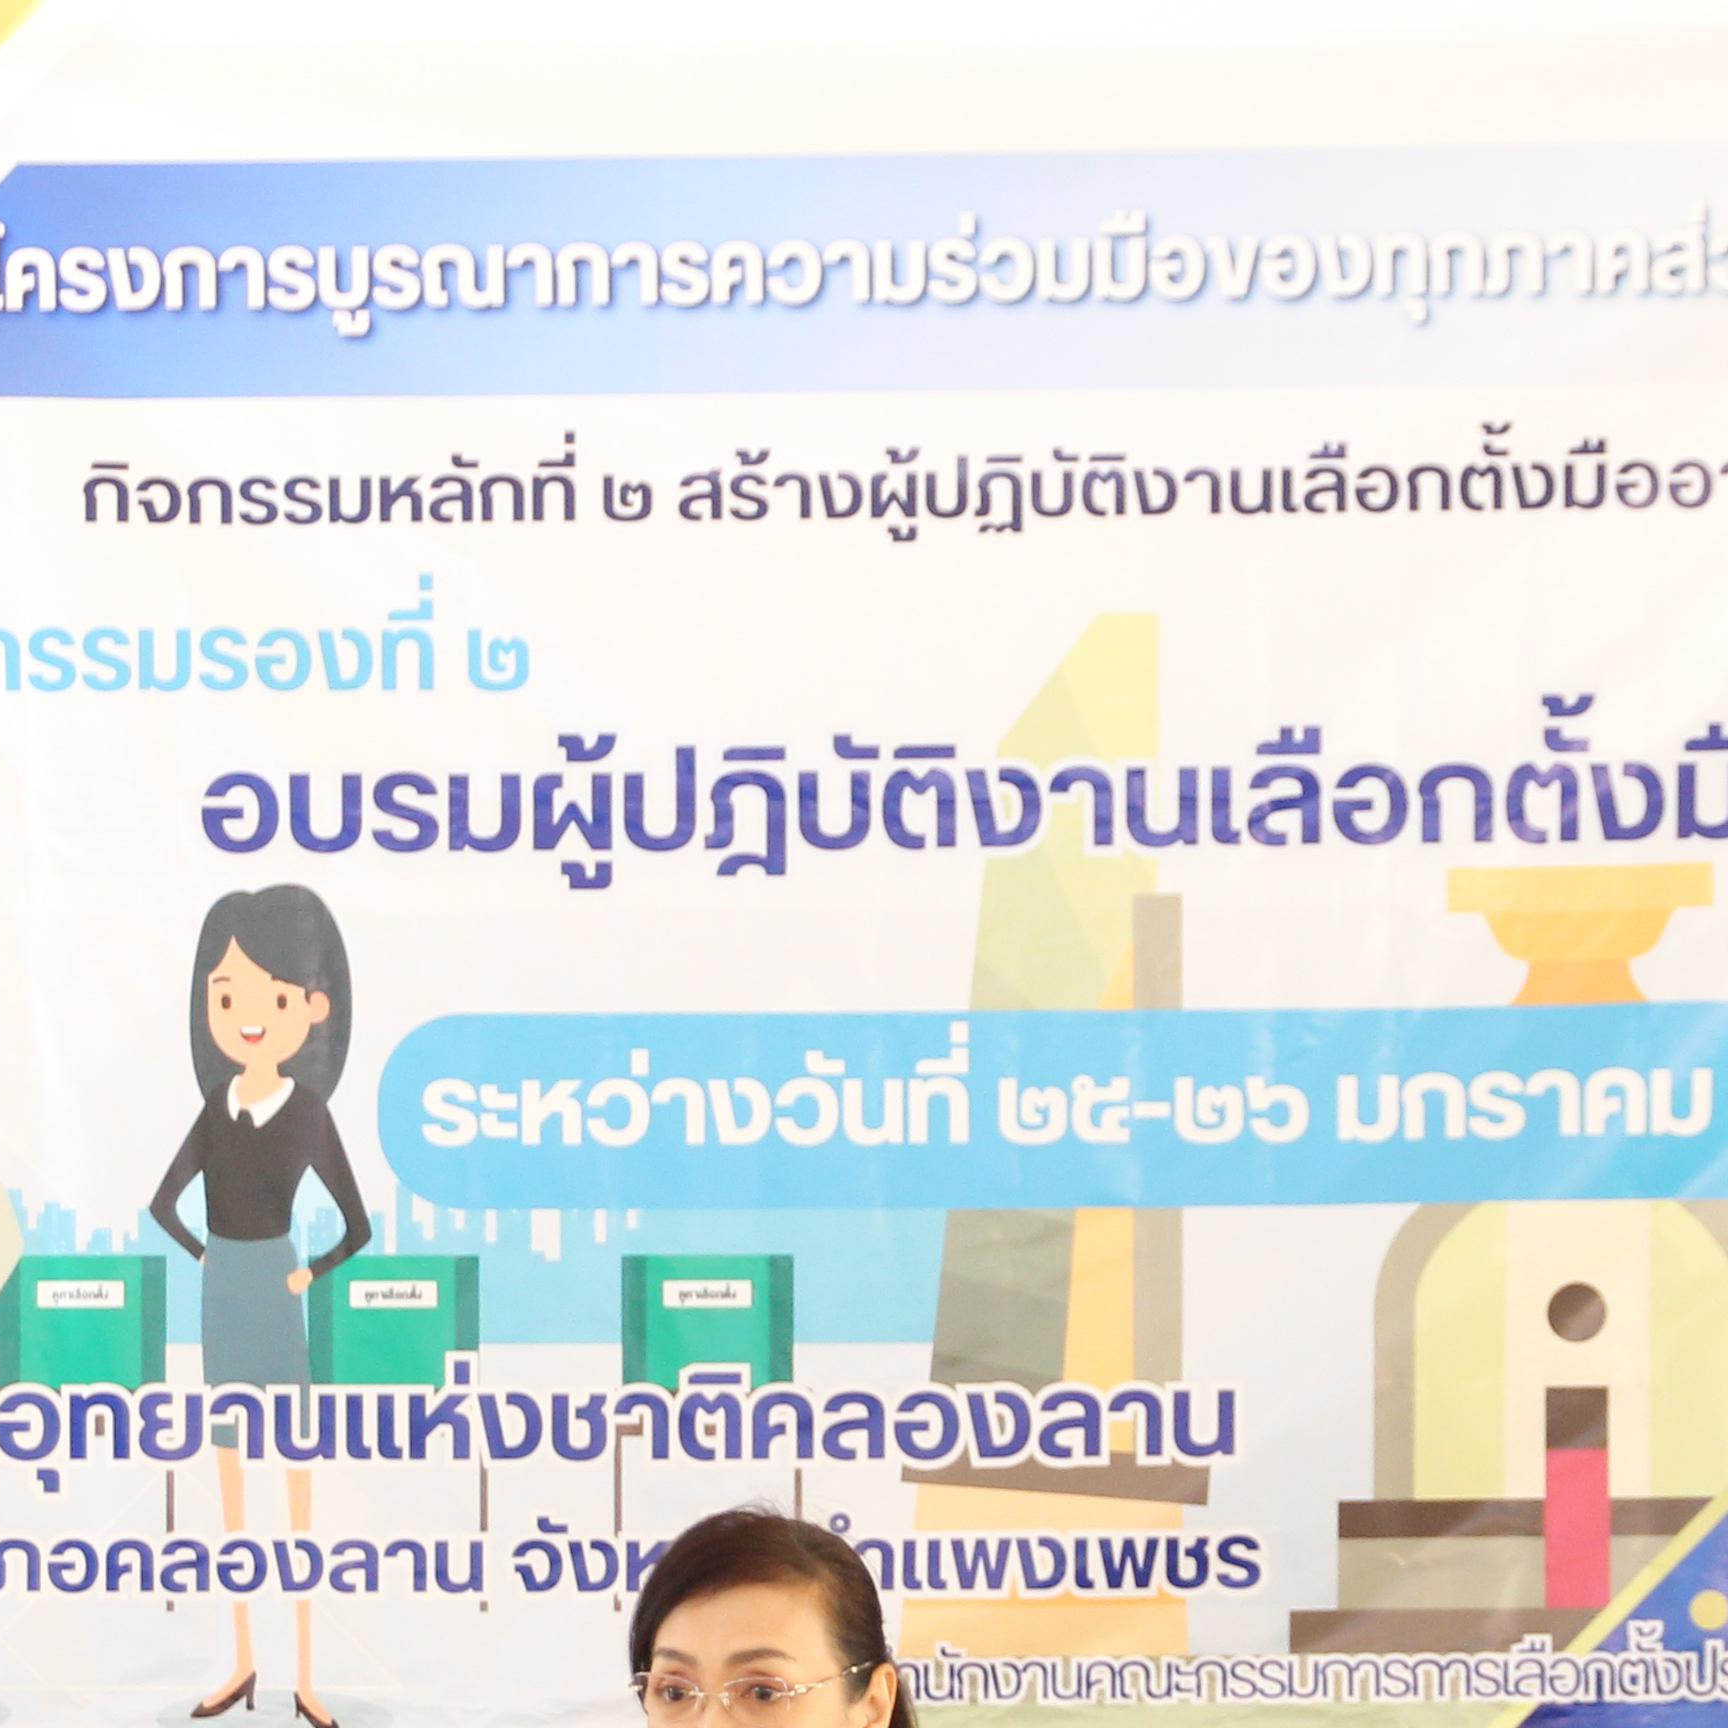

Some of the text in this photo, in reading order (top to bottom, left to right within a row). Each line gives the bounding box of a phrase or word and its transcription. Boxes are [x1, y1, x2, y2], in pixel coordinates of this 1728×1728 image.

[82, 431, 577, 526] กิจกรรมหลักที่
[602, 473, 654, 522] ๒
[467, 622, 531, 693] ๒
[420, 1021, 970, 1149] ระหว่างวันที่
[997, 1064, 1309, 1147] ๒๕-๒๖
[1337, 1066, 1713, 1145] มกราคม
